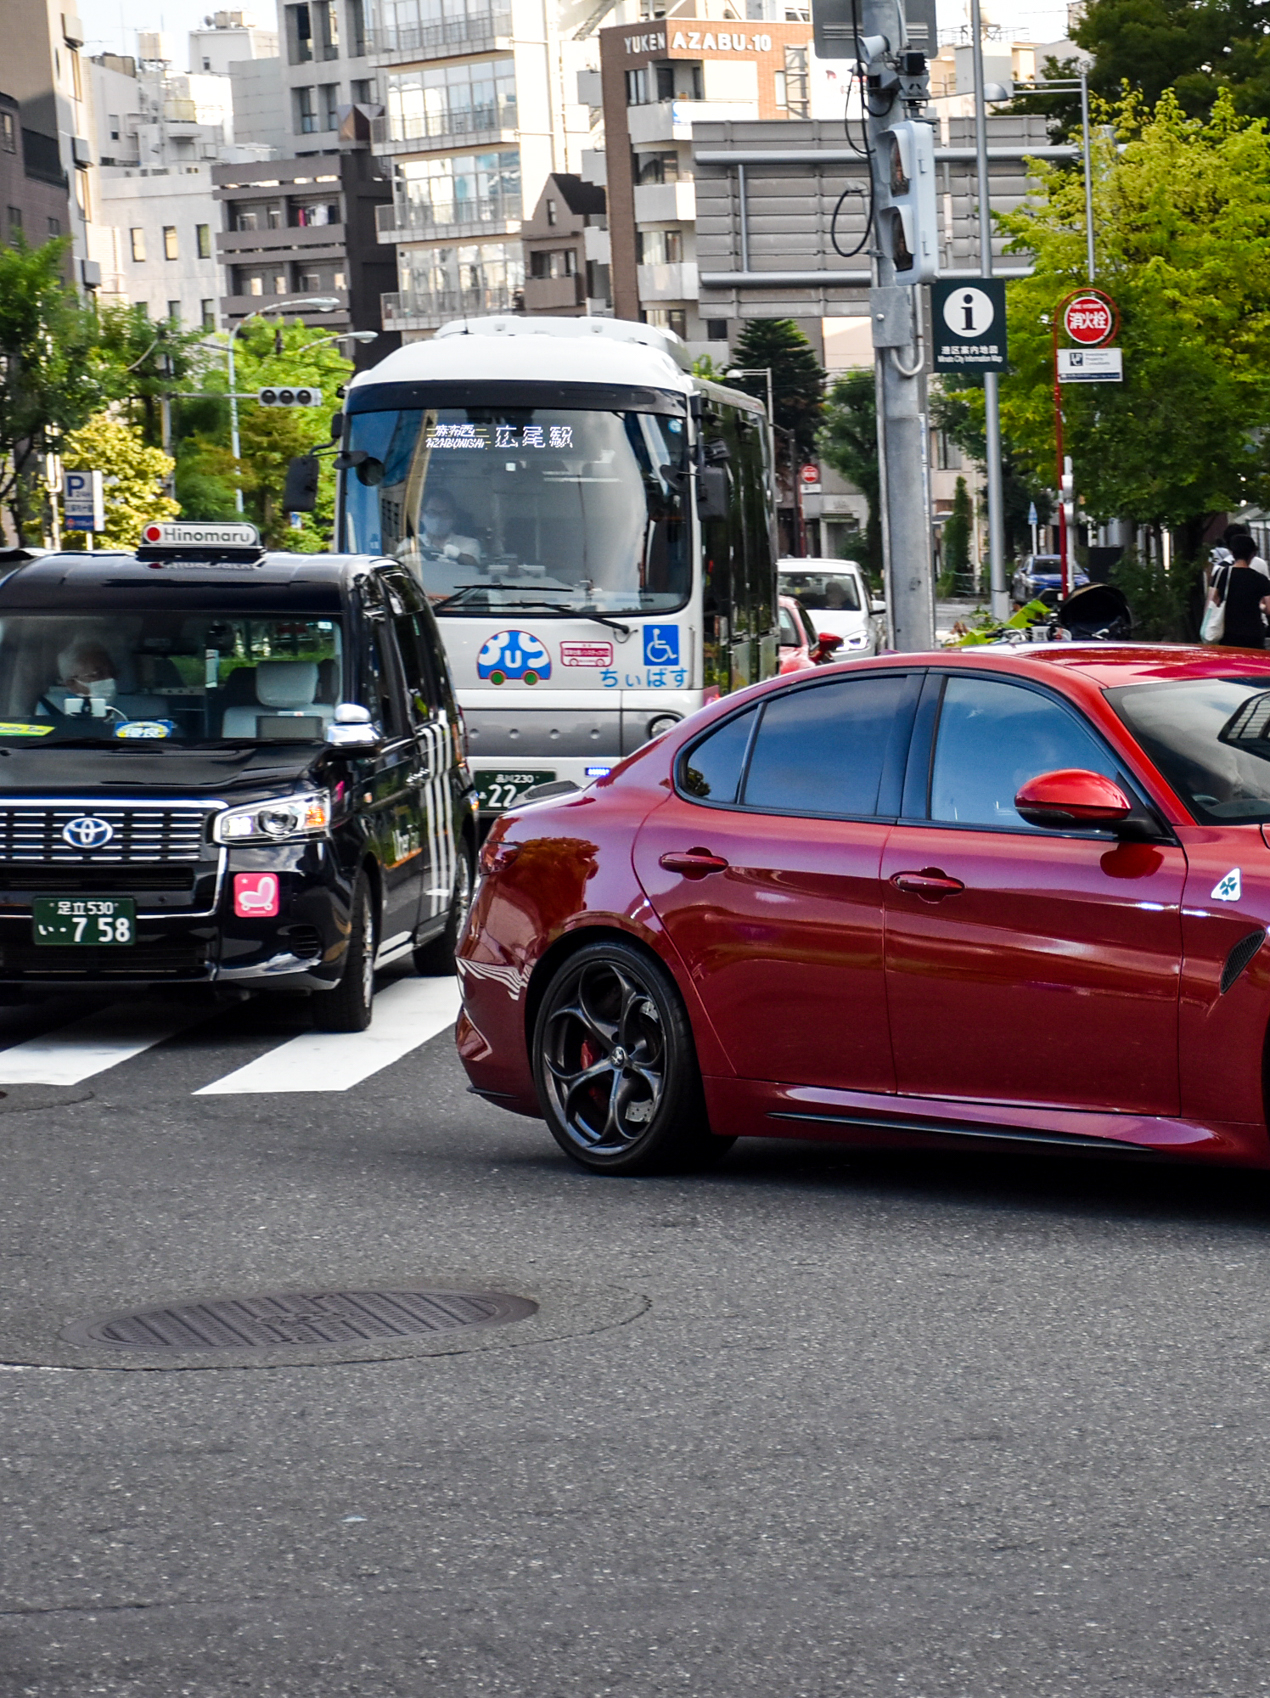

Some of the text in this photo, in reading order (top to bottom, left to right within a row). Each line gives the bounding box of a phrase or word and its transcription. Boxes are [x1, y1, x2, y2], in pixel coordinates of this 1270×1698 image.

[624, 32, 666, 54] YUKEN
[1069, 311, 1107, 330] 消火栓
[67, 475, 85, 497] P
[165, 527, 250, 542] Hinomaru
